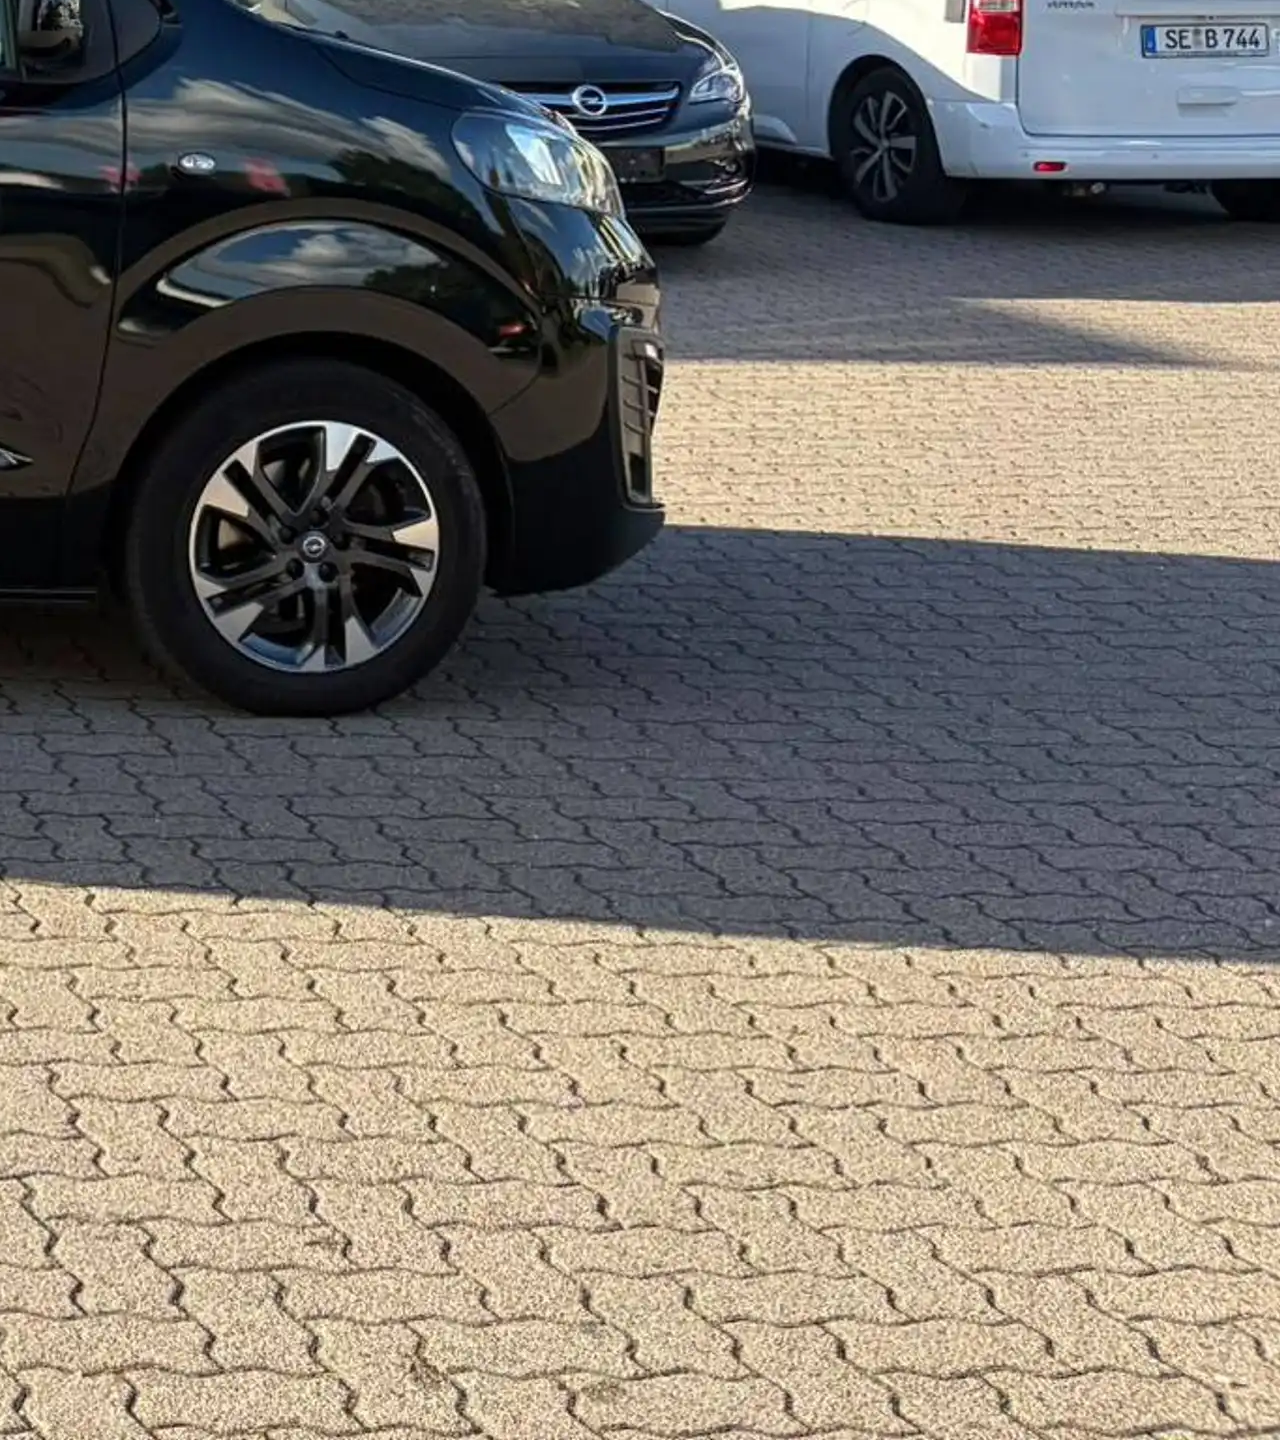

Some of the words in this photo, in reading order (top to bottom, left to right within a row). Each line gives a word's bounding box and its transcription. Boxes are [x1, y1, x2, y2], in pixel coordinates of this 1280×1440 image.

[1164, 29, 1192, 50] SE
[1205, 28, 1218, 49] B
[1223, 28, 1261, 49] 744
